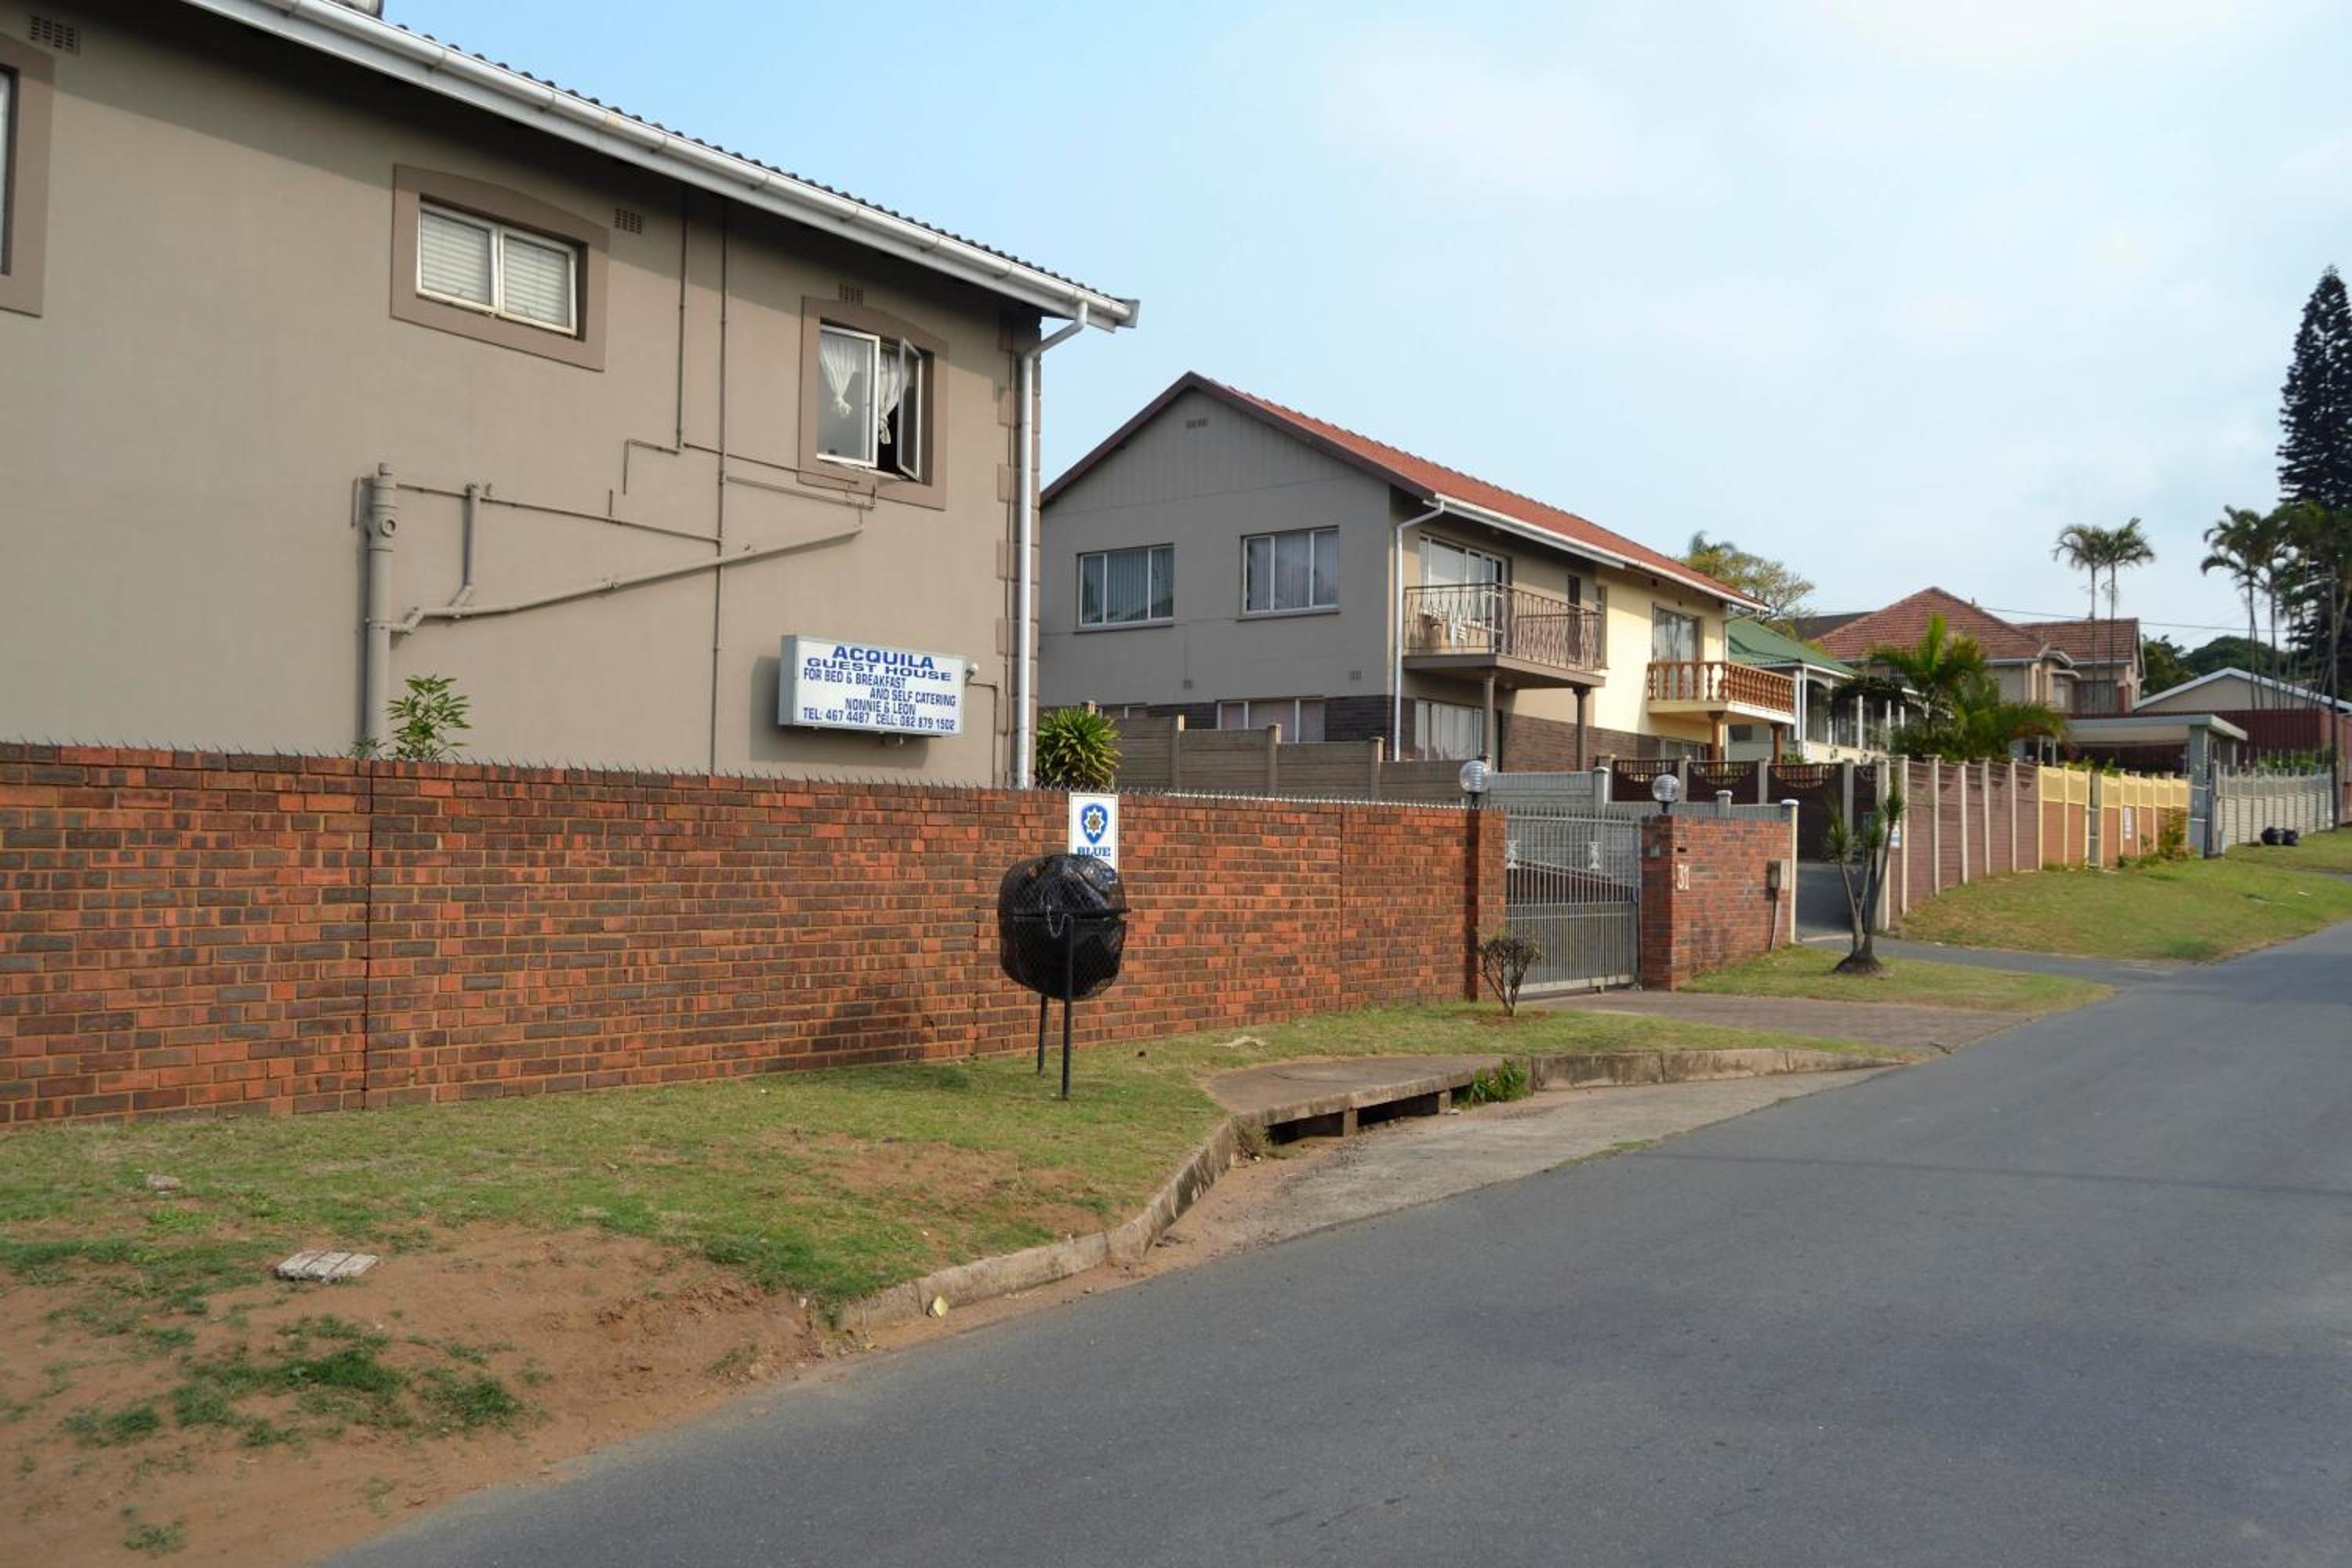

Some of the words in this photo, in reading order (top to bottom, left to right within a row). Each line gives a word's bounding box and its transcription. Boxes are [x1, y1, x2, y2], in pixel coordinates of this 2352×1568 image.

[833, 645, 934, 670] ACQUILA
[804, 667, 822, 681] FOR
[824, 670, 844, 683] BED
[855, 673, 906, 689] BREAKFAST
[807, 658, 877, 673] GUEST
[885, 666, 952, 681] HOUSE
[845, 698, 881, 713] NONNIE
[893, 702, 916, 716] LEON
[869, 688, 890, 701] AND
[892, 689, 913, 702] SELF
[915, 691, 956, 706] CATERING
[826, 709, 844, 721] 467
[847, 711, 869, 724] 4487
[918, 717, 934, 729] 879
[1076, 846, 1111, 857] BLUE
[1677, 865, 1690, 890] 31
